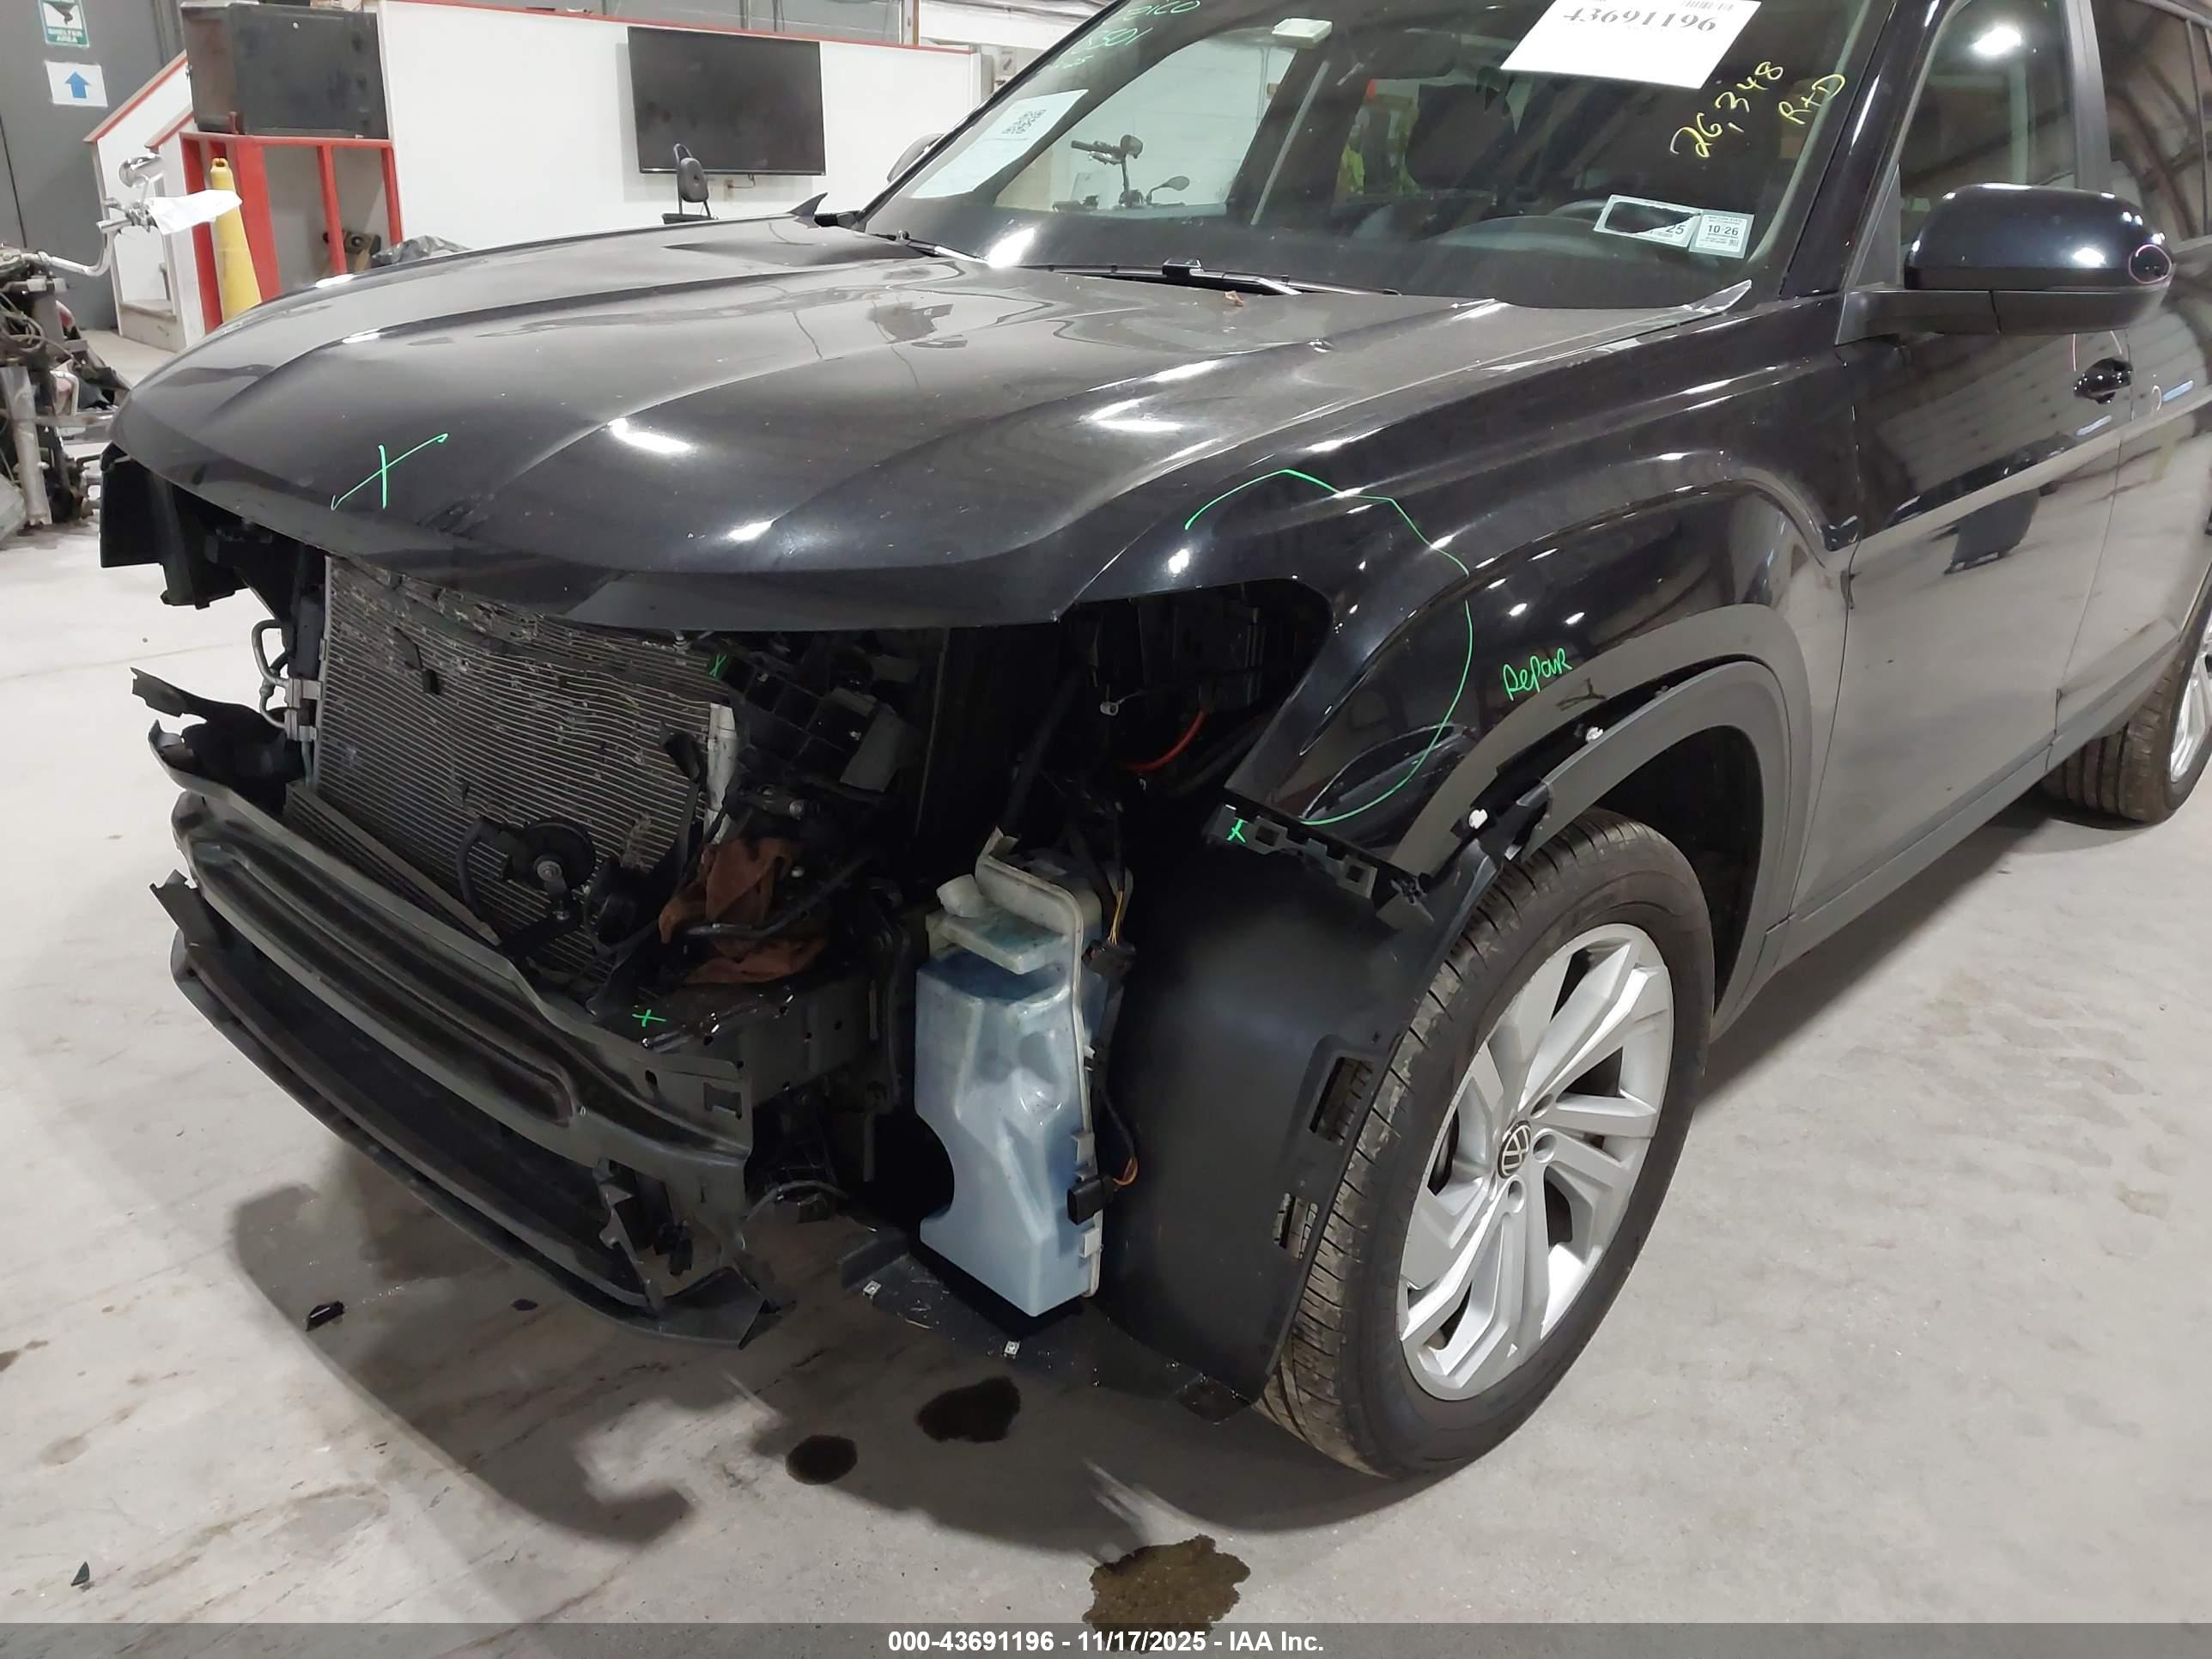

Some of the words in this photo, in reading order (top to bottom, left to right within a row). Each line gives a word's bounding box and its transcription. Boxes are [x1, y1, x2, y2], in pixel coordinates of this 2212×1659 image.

[1563, 7, 1717, 32] 43691196
[1669, 61, 1784, 158] 26,348
[1708, 224, 1721, 234] 10
[1723, 226, 1739, 236] 26
